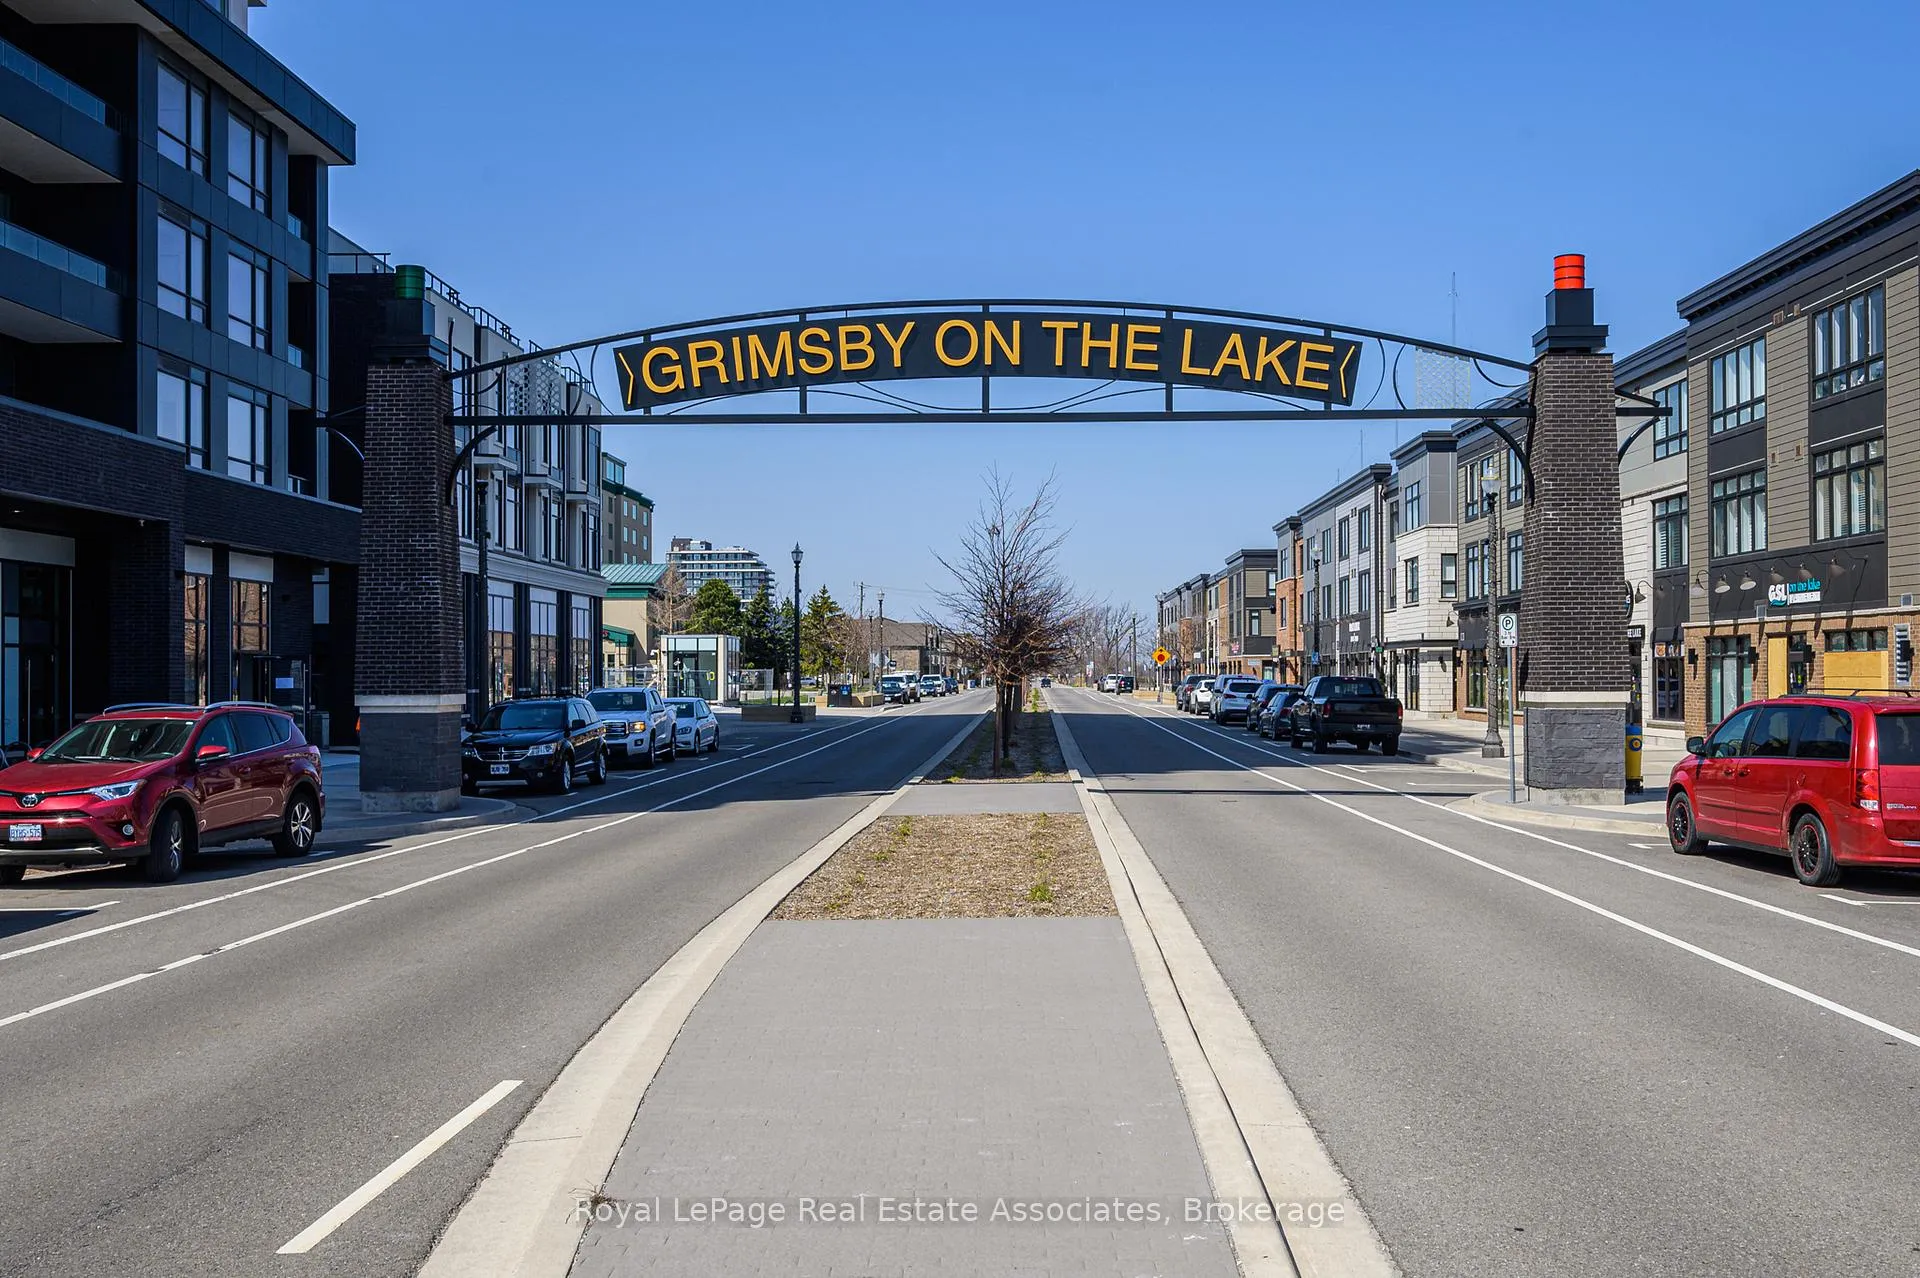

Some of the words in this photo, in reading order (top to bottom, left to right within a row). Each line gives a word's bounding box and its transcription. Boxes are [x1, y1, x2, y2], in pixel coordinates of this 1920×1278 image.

[642, 323, 917, 393] GRIMSBY
[937, 319, 1019, 367] ON
[1043, 323, 1160, 371] THE
[1182, 331, 1334, 389] LAKE
[1769, 583, 1787, 603] GSL
[1808, 578, 1820, 590] lake
